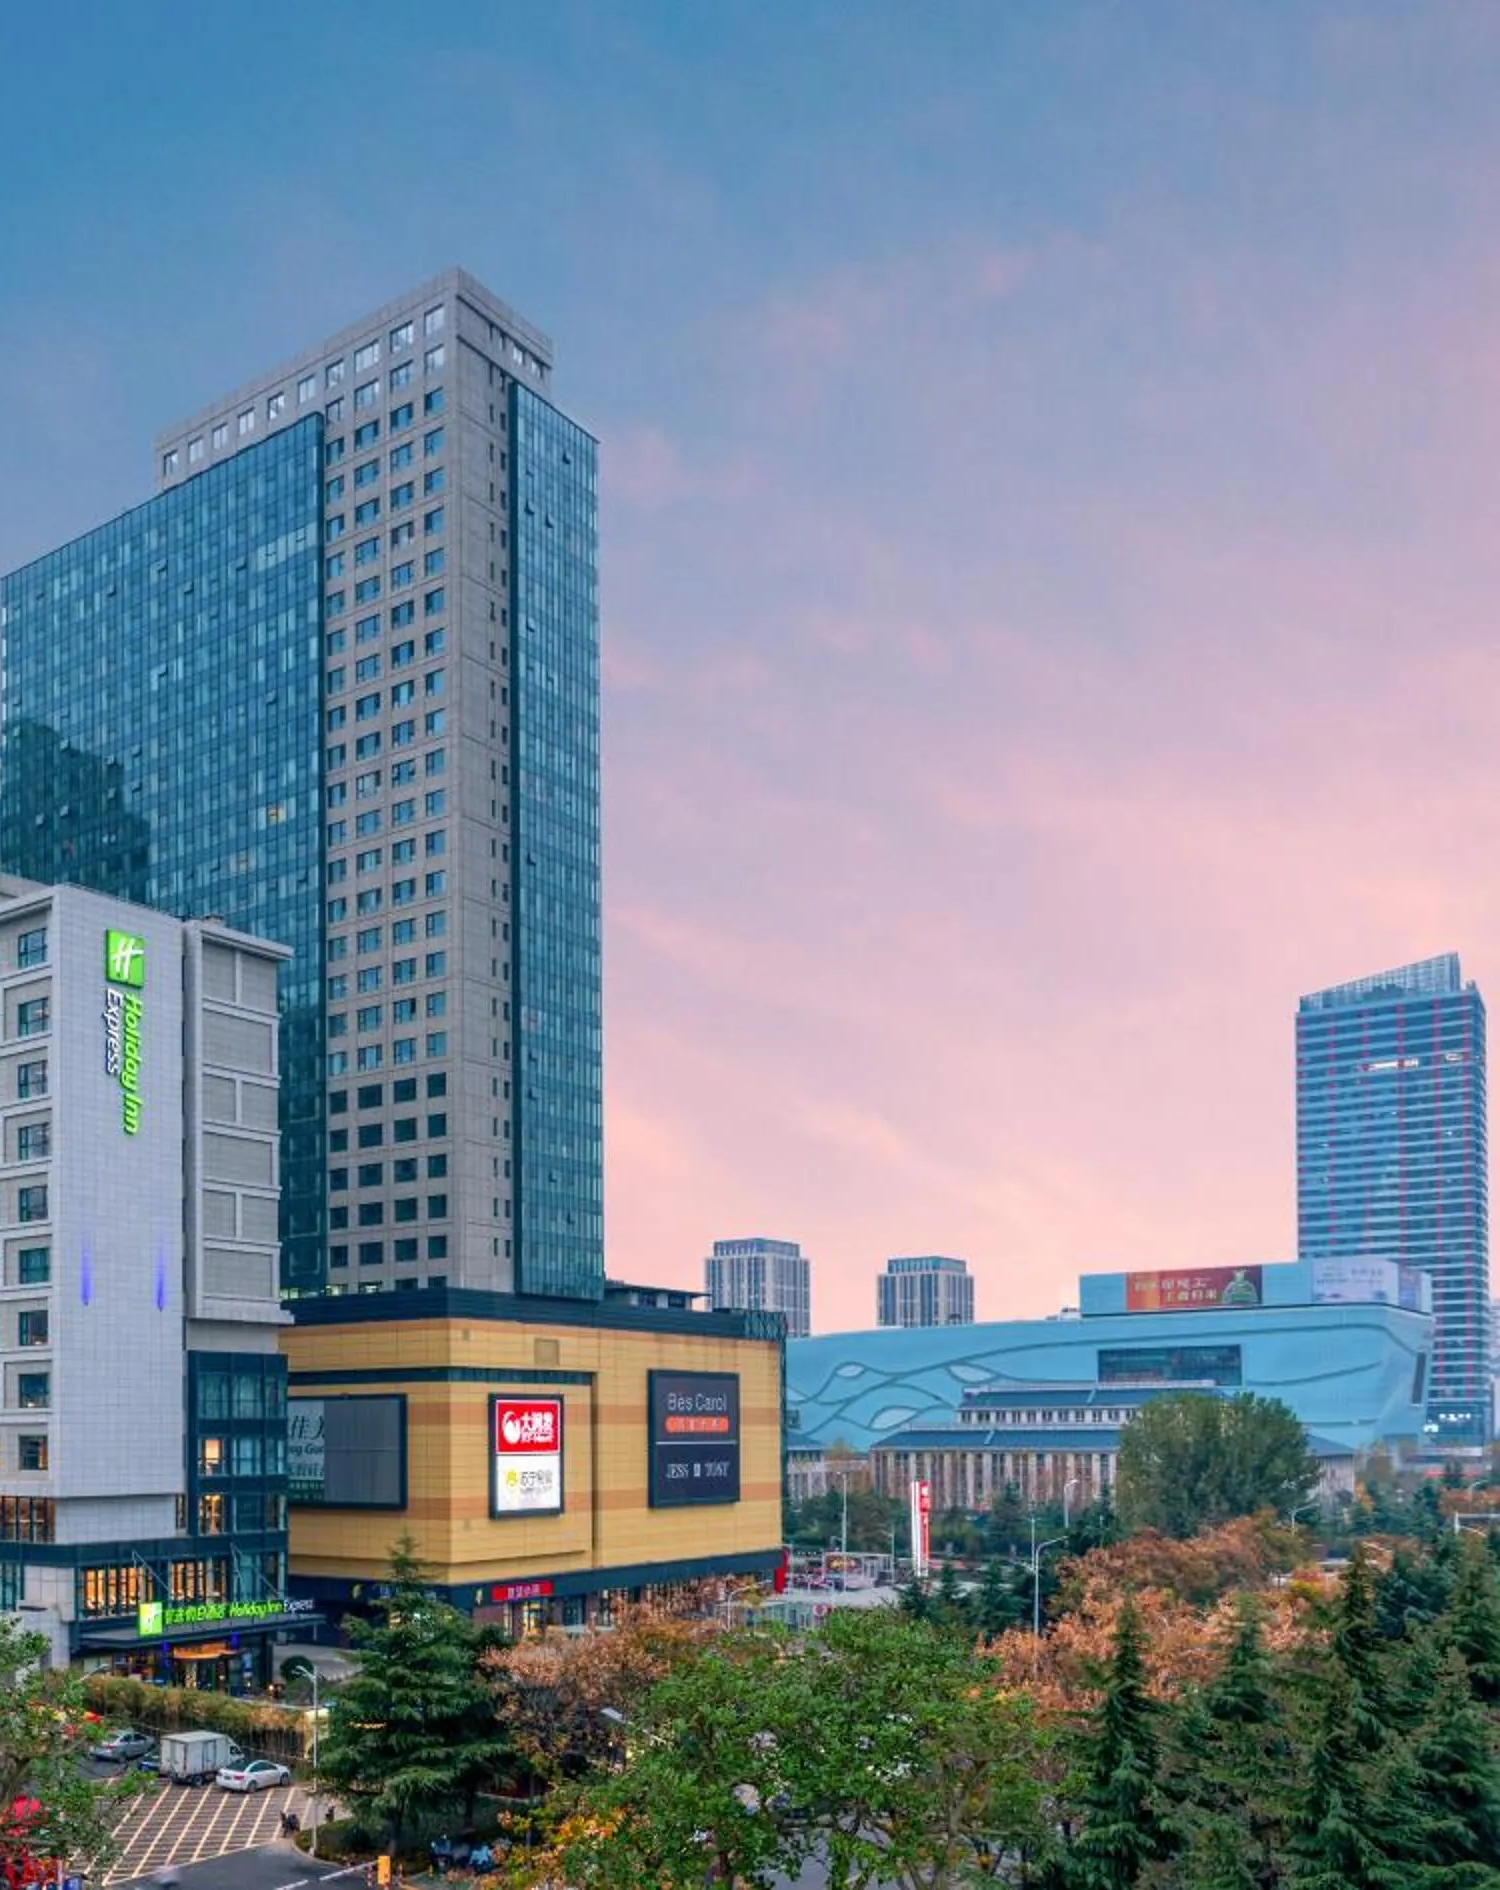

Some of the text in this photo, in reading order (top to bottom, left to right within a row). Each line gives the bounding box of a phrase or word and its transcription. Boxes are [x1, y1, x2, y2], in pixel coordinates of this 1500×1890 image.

[101, 988, 123, 1077] Express
[120, 991, 143, 1136] Holiday Inn
[229, 1600, 267, 1619] Holiday
